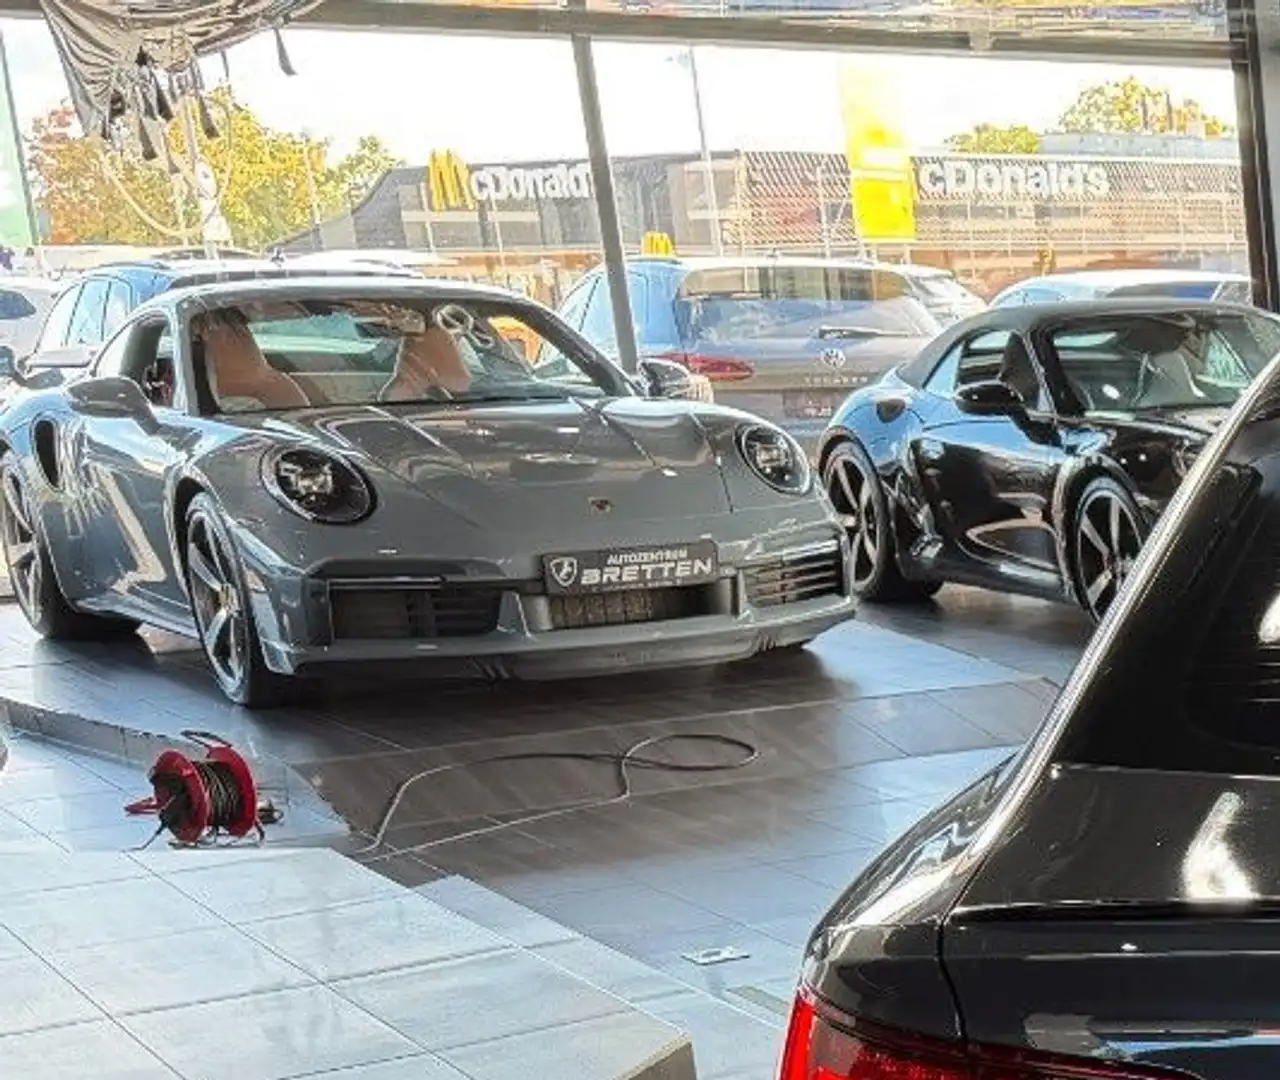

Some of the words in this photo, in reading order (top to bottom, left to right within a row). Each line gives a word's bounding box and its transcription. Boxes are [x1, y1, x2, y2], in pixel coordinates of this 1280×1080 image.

[429, 149, 597, 214] McDonald
[918, 158, 1110, 200] cDonald's
[581, 557, 712, 585] BRETTEN
